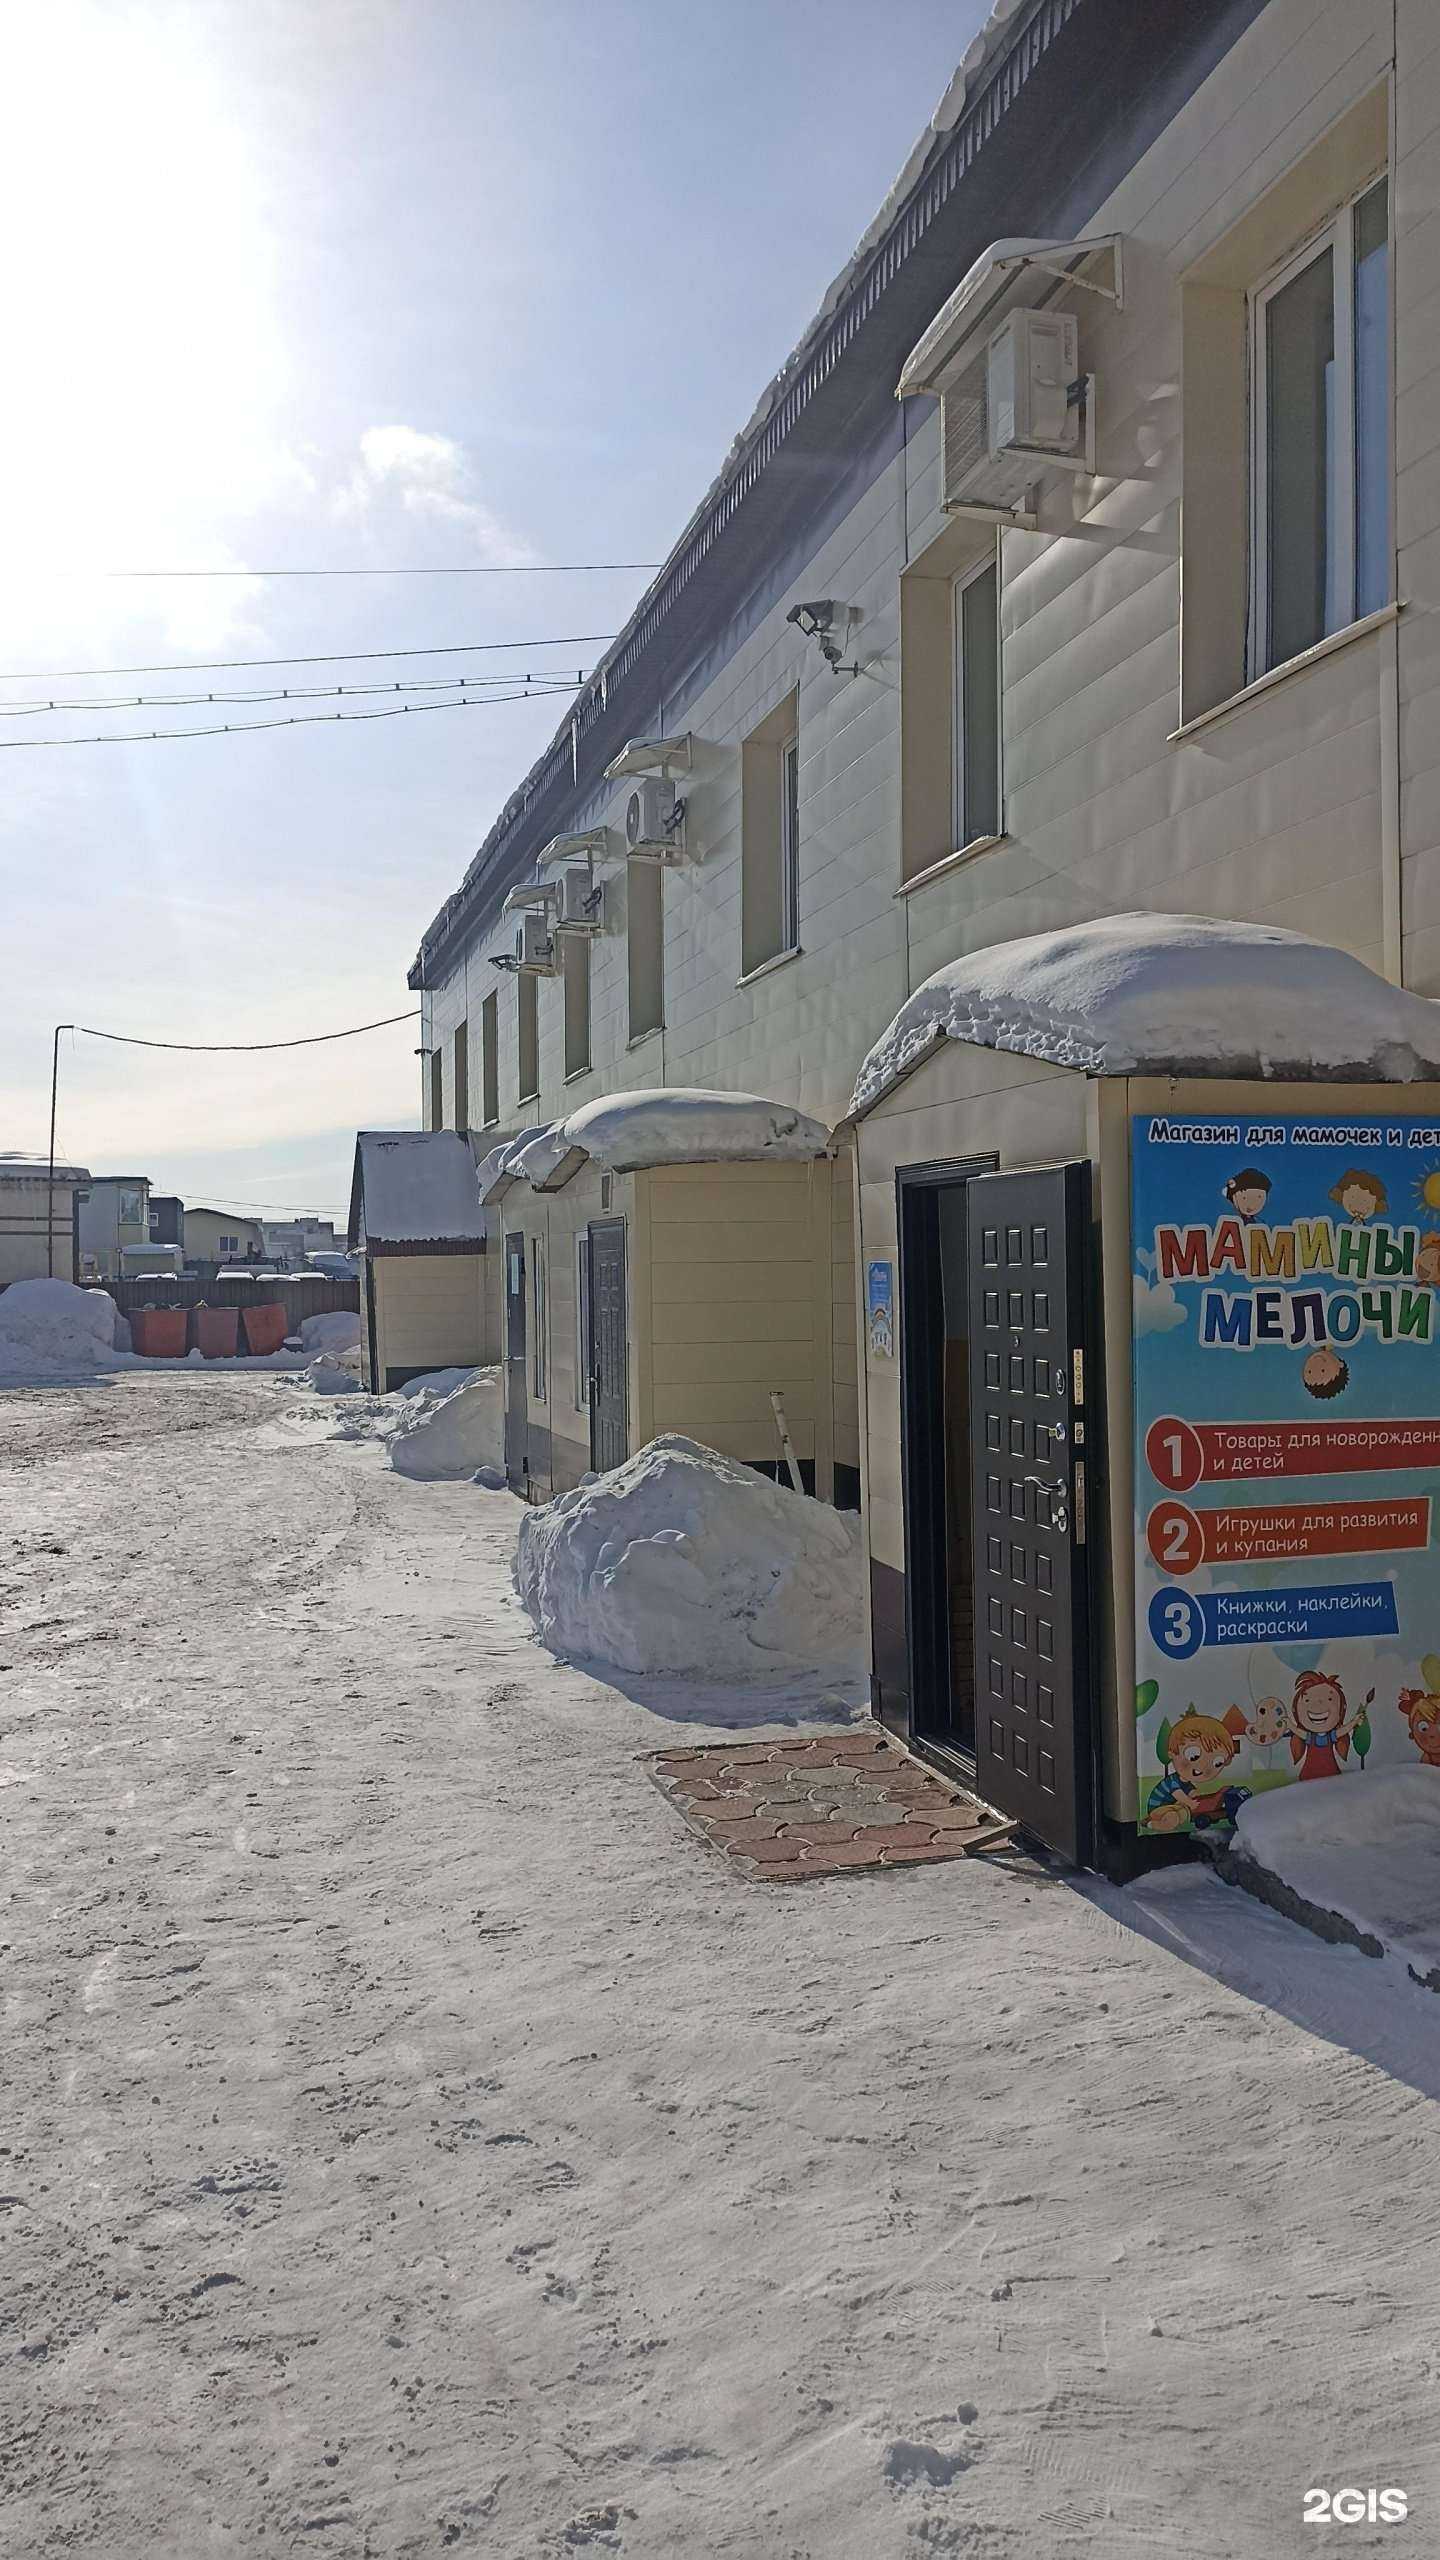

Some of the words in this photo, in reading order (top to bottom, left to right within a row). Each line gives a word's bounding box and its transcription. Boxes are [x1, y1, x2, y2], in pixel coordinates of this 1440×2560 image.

[1150, 1119, 1240, 1145] Магазин
[1246, 1127, 1284, 1146] для
[1292, 1127, 1380, 1145] мамочек
[1388, 1130, 1401, 1145] и
[1159, 1220, 1415, 1279] МАМИНЫ
[1204, 1289, 1432, 1346] МЕЛОЧИ
[1163, 1435, 1182, 1477] 1
[1214, 1432, 1281, 1453] Товары
[1287, 1433, 1321, 1449] для
[1213, 1457, 1224, 1470] и
[1231, 1453, 1284, 1471] детей
[1216, 1515, 1295, 1537] Игрушки
[1302, 1517, 1334, 1531] для
[1341, 1512, 1418, 1532] развития
[1163, 1518, 1189, 1561] 2
[1216, 1540, 1228, 1553] и
[1234, 1538, 1308, 1556] купания
[1164, 1602, 1191, 1646] 3
[1217, 1621, 1308, 1641] раскраски
